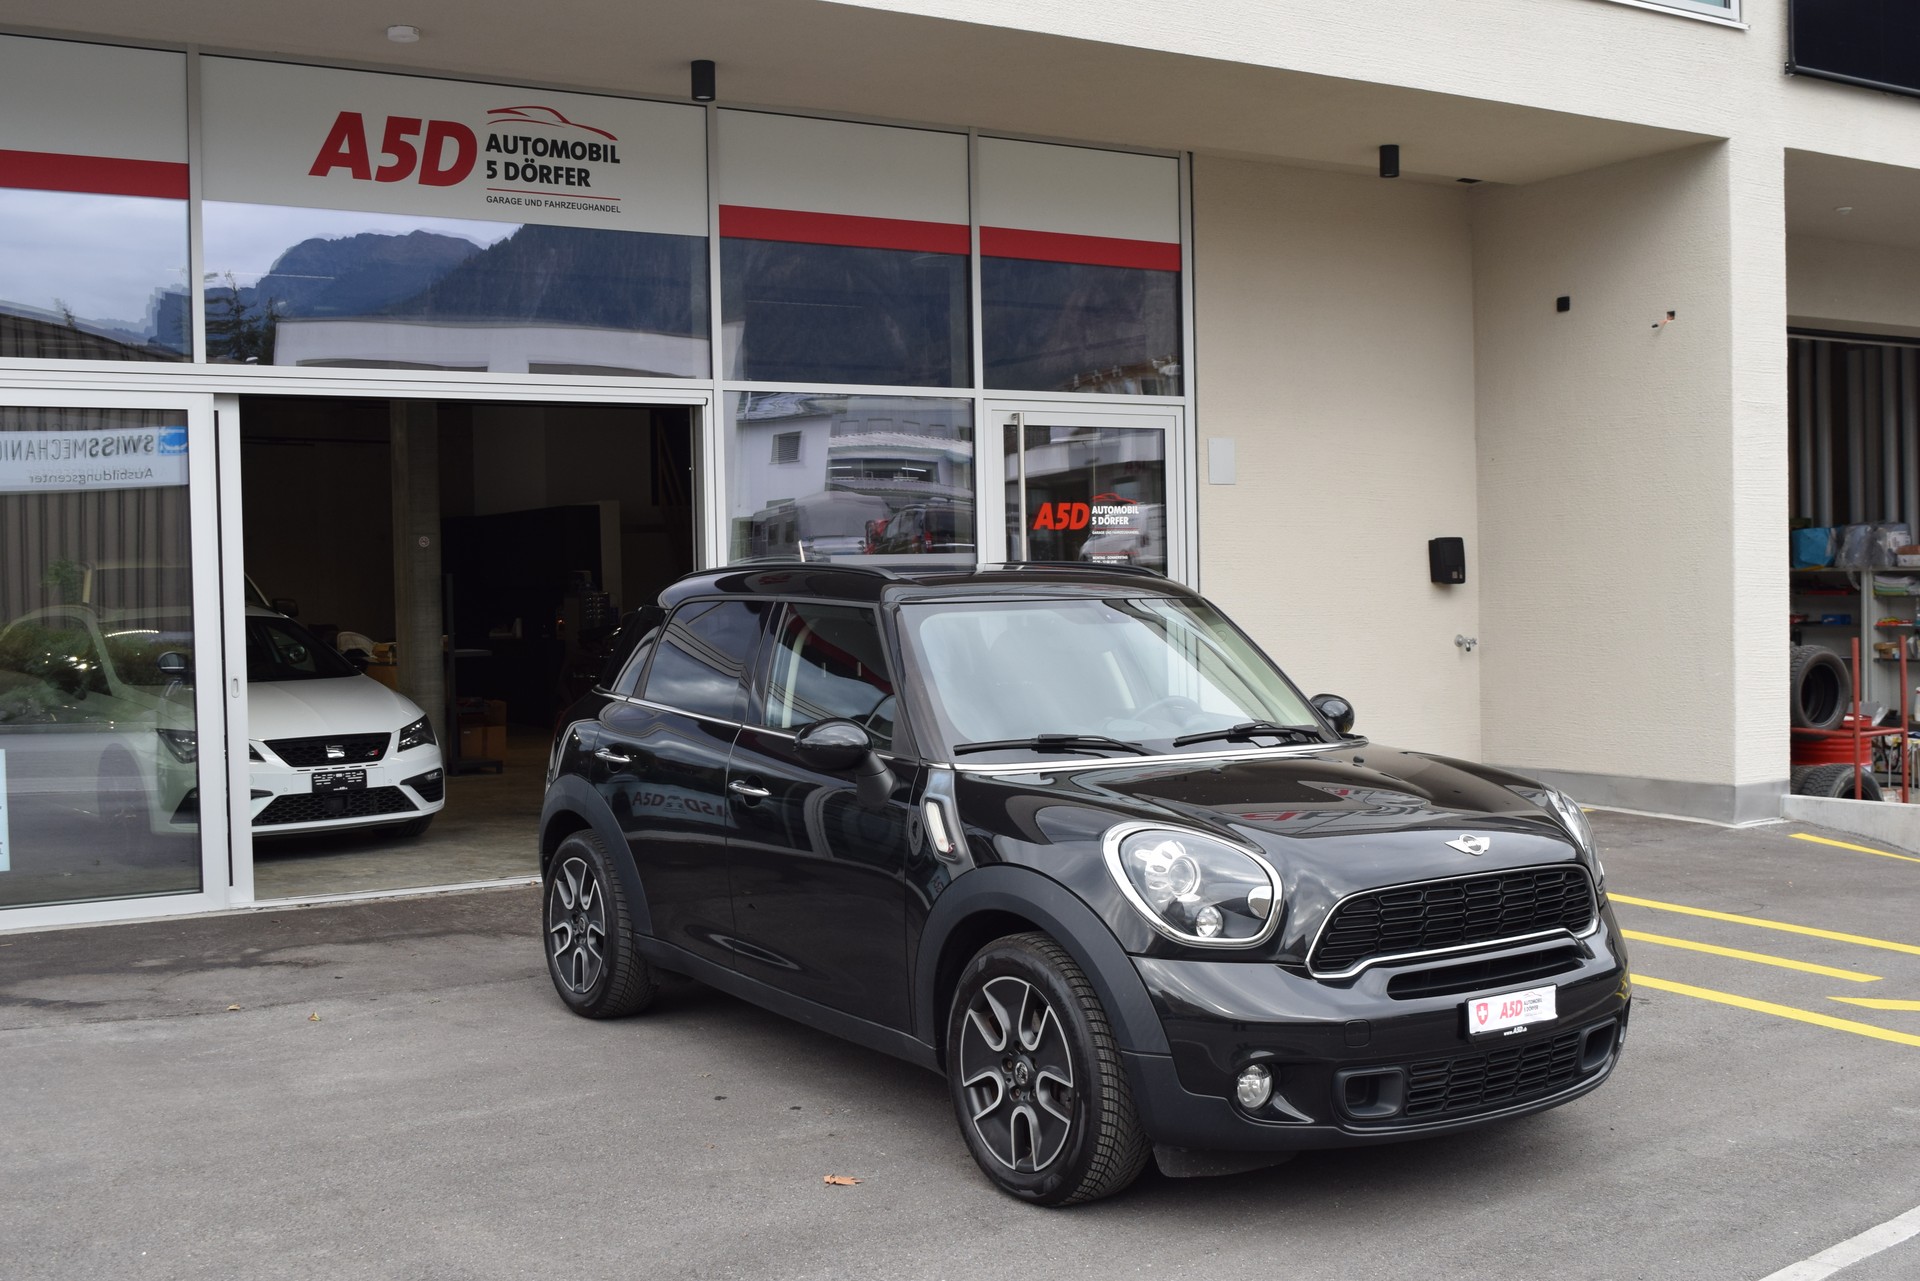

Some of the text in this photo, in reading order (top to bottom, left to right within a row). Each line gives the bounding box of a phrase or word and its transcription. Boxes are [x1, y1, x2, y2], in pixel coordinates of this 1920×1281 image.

[308, 111, 478, 187] A5D
[485, 133, 621, 164] AUTOMOBIL
[486, 158, 591, 187] 5 DÖRFER
[486, 195, 621, 213] GARAGE UND FAHRZEUGHANDEL
[1033, 502, 1091, 530] A5D
[1092, 505, 1139, 514] AUTOMOBIL
[1092, 514, 1129, 525] 5 DÖRFER
[1500, 1000, 1522, 1019] A5D
